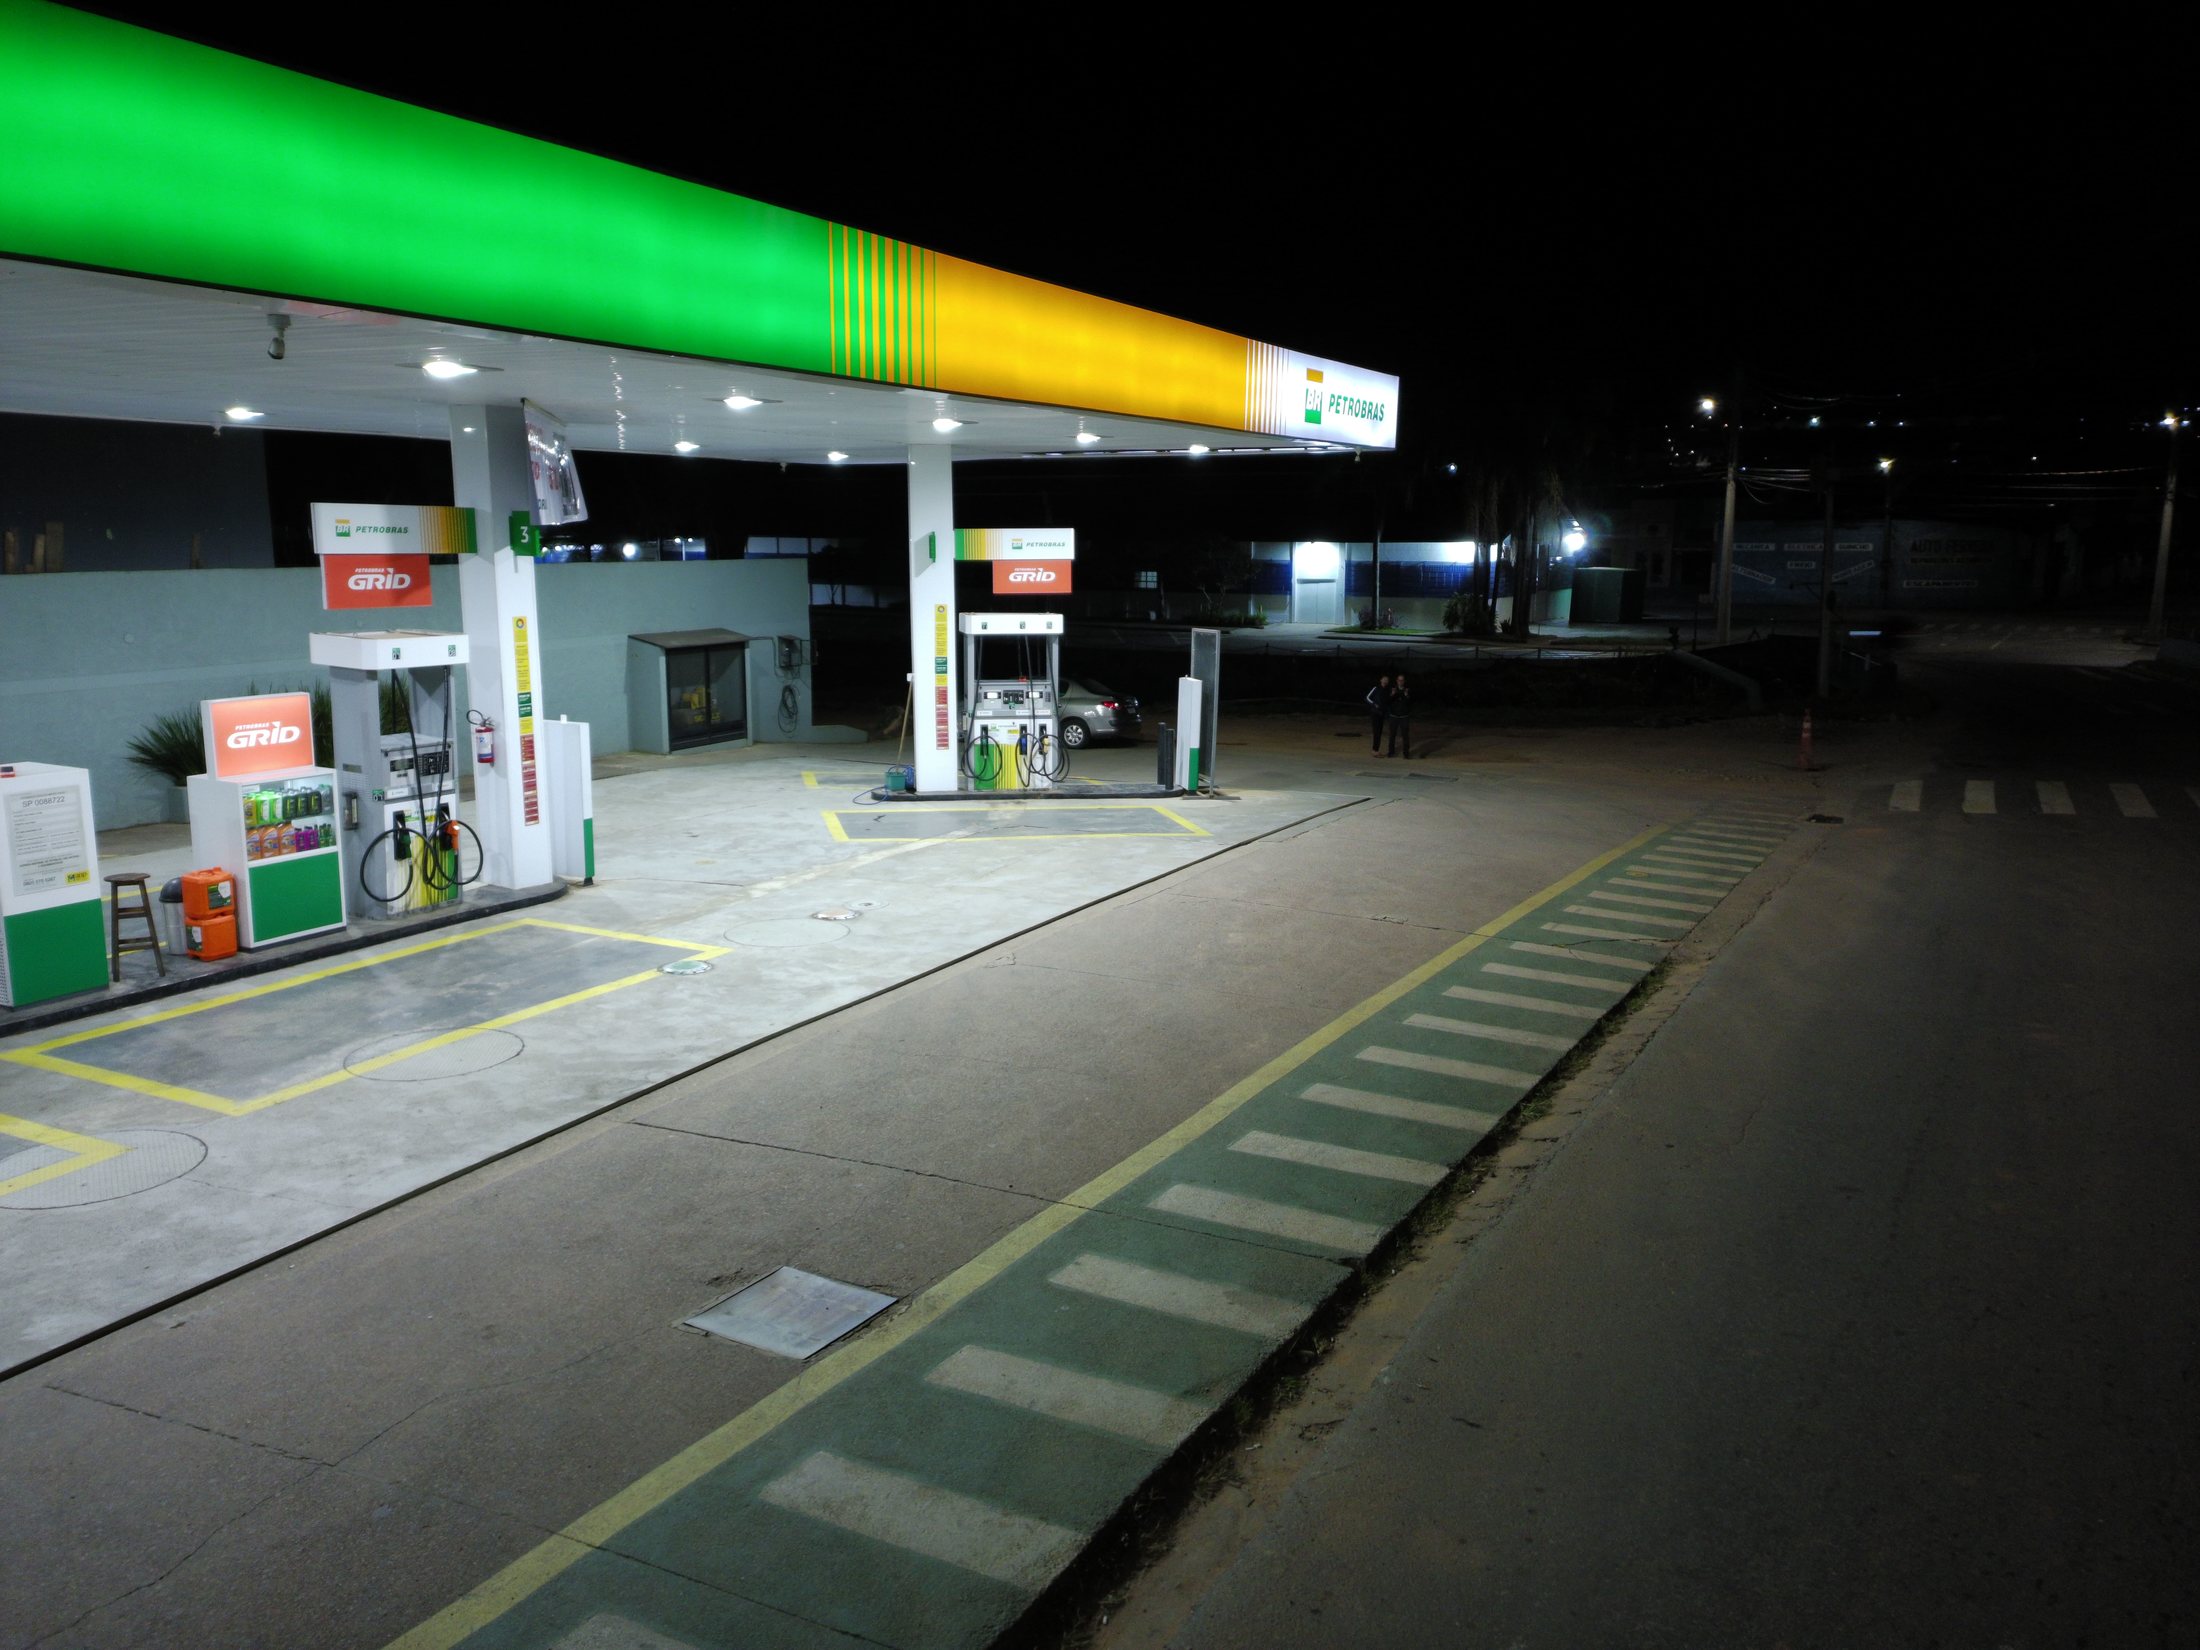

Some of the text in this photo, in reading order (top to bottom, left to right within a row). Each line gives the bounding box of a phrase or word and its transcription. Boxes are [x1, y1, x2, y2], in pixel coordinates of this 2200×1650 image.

[1329, 394, 1385, 422] PETROBRAS
[355, 525, 409, 535] PETROBRAS
[520, 526, 529, 543] 3
[227, 721, 301, 749] GRID
[22, 799, 33, 808] SP
